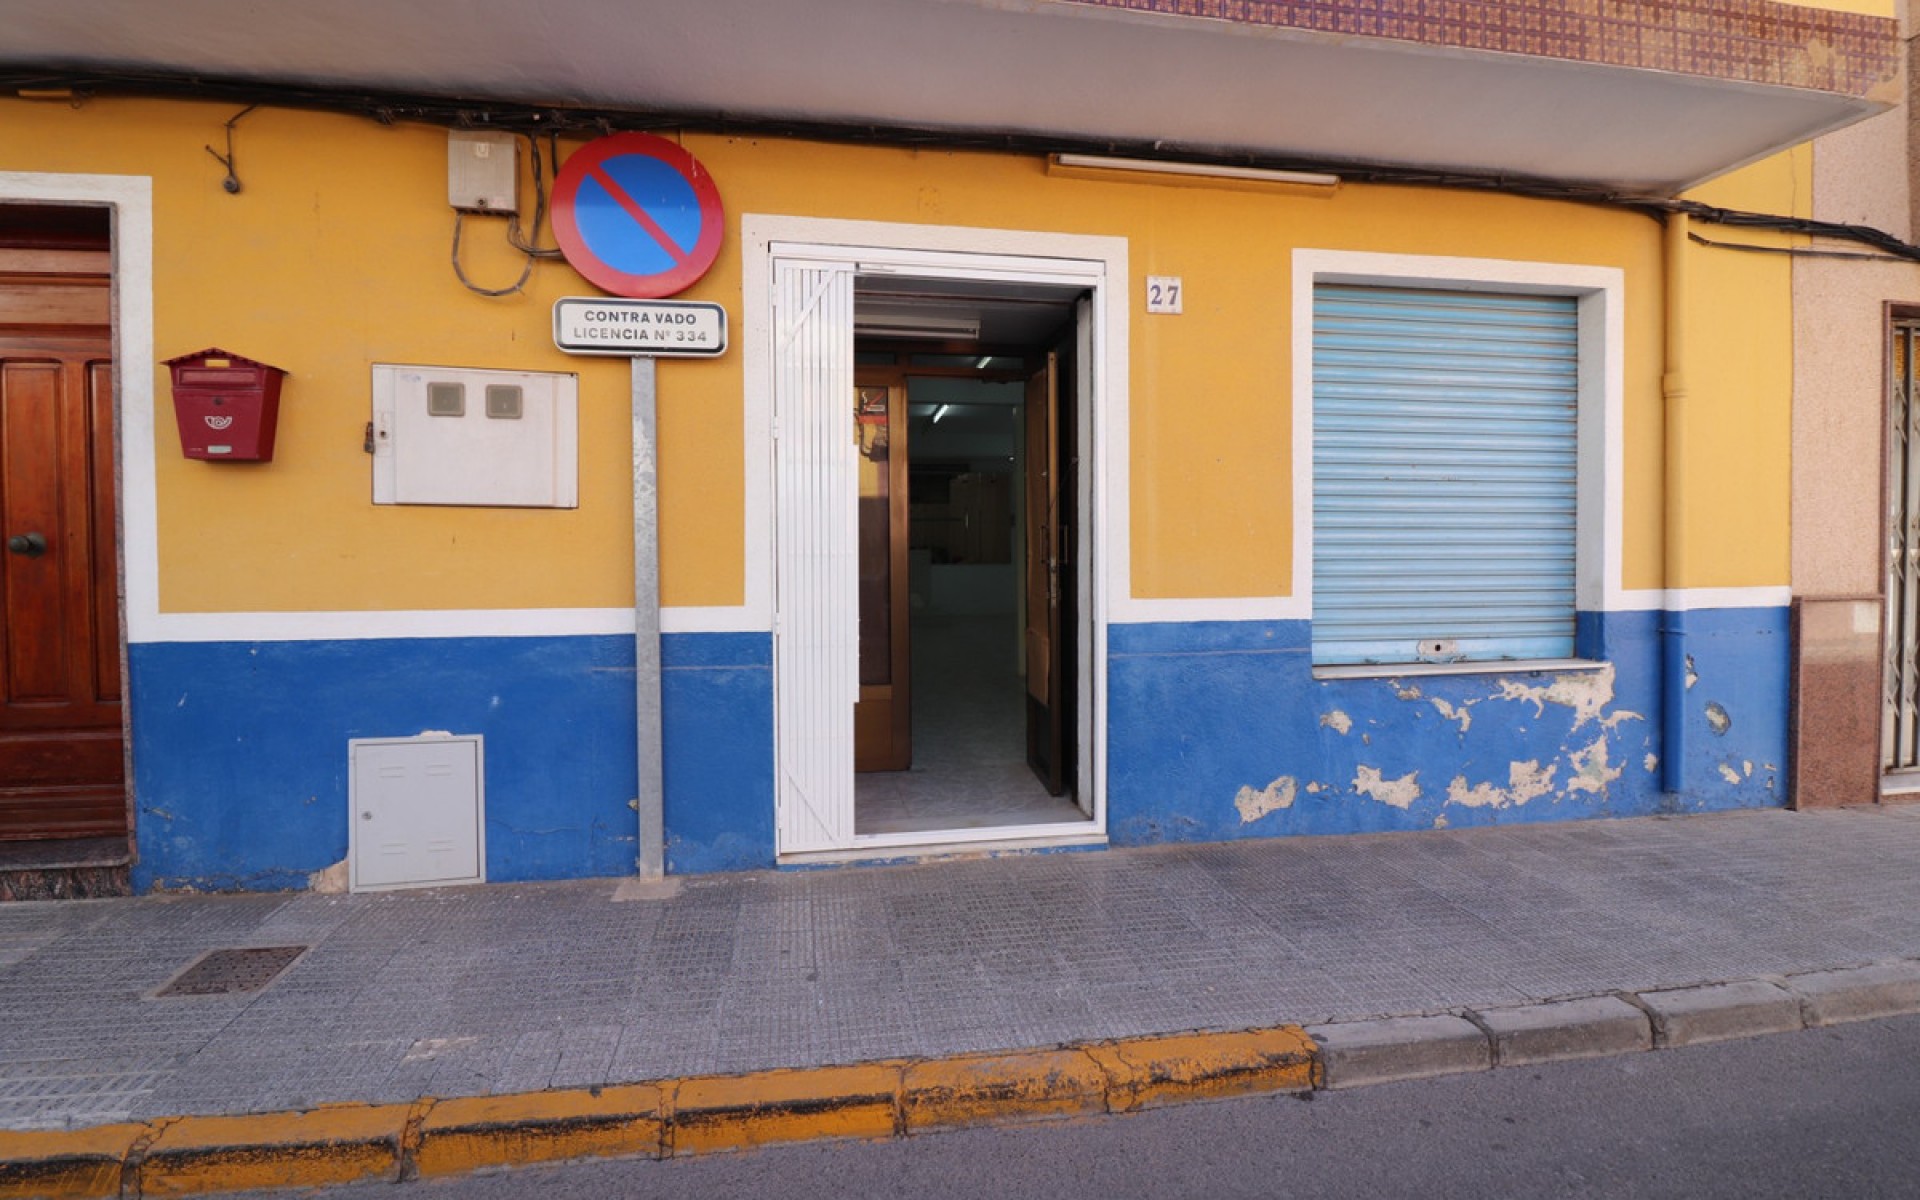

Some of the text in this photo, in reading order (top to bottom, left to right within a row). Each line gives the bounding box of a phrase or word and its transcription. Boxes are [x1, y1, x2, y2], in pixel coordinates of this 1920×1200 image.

[1150, 285, 1179, 305] 27
[584, 310, 697, 325] CONTRA VADO
[573, 327, 649, 340] LICENCIA
[676, 330, 707, 342] 334
